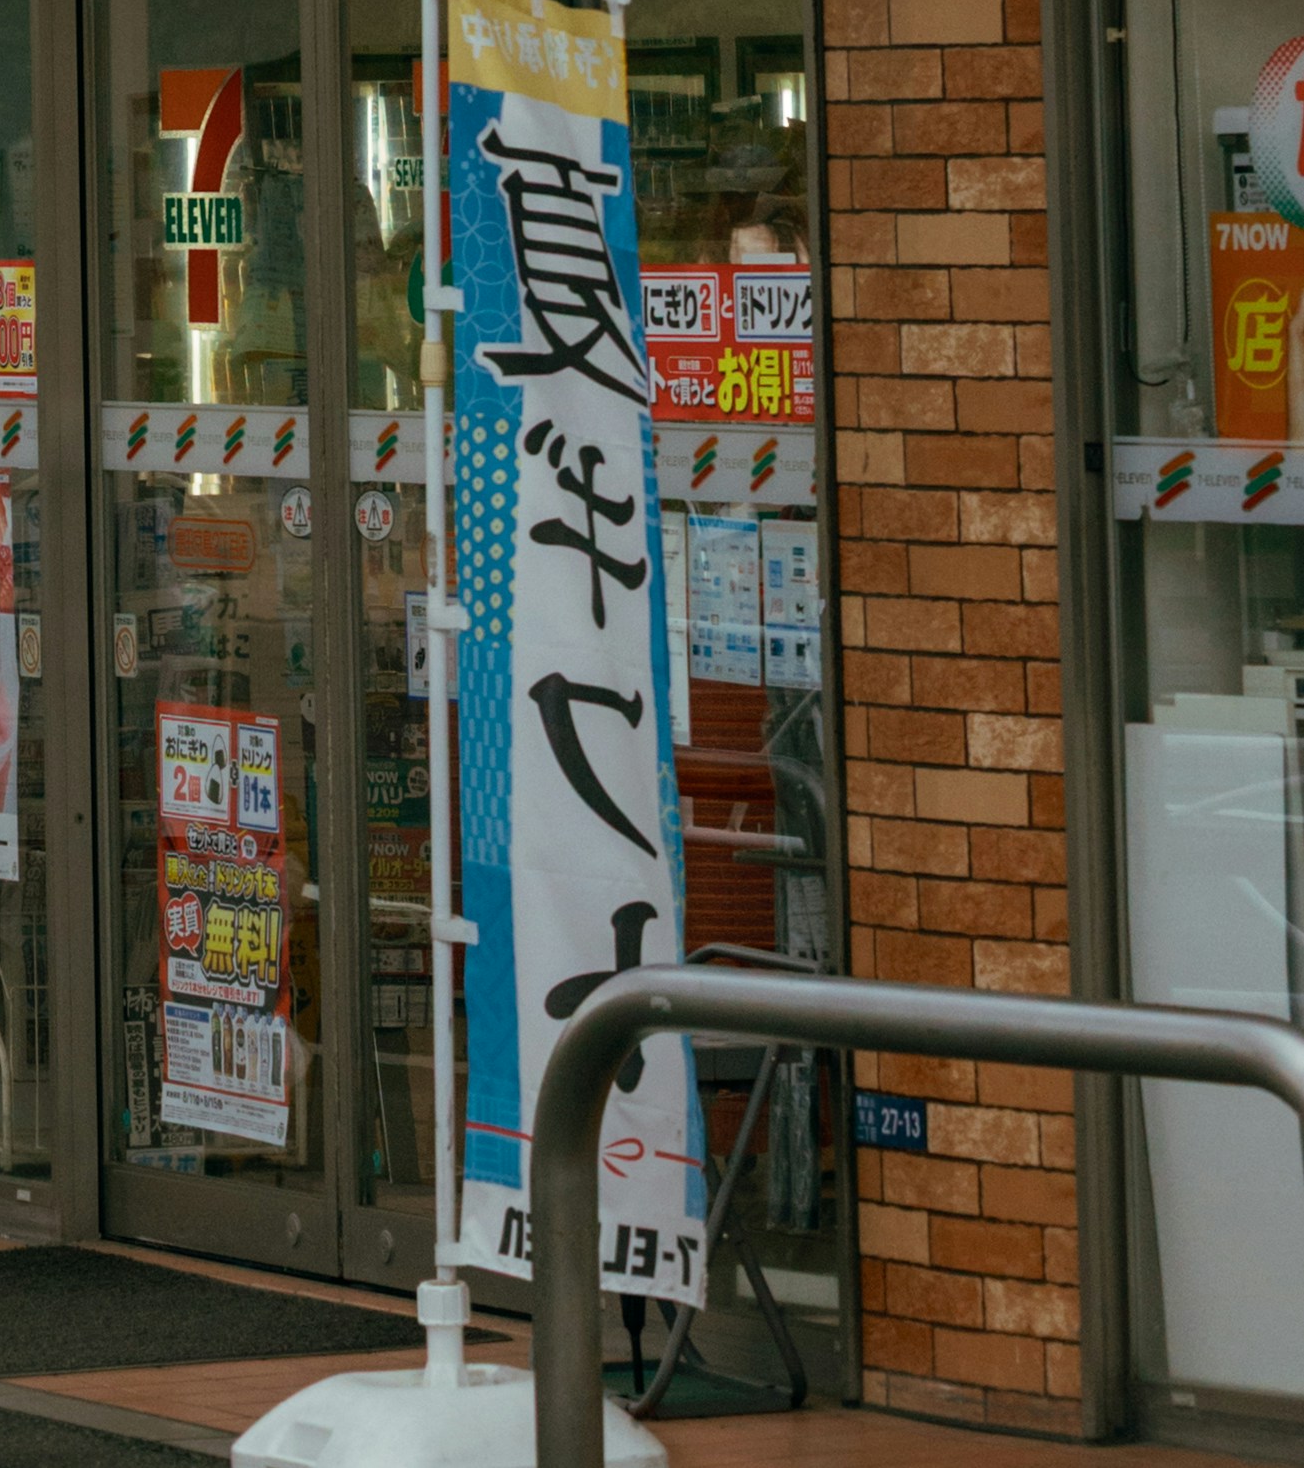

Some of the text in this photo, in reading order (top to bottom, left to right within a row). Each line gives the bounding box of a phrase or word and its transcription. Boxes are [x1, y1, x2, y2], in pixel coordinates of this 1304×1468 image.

[1216, 224, 1289, 251] 7NOW
[1227, 290, 1289, 373] 店
[718, 347, 792, 415] お得!
[165, 737, 209, 762] おにぎり
[241, 748, 273, 771] ドリンク
[167, 900, 200, 940] 実質
[202, 902, 281, 982] 無料!
[881, 1107, 921, 1138] 27-13
